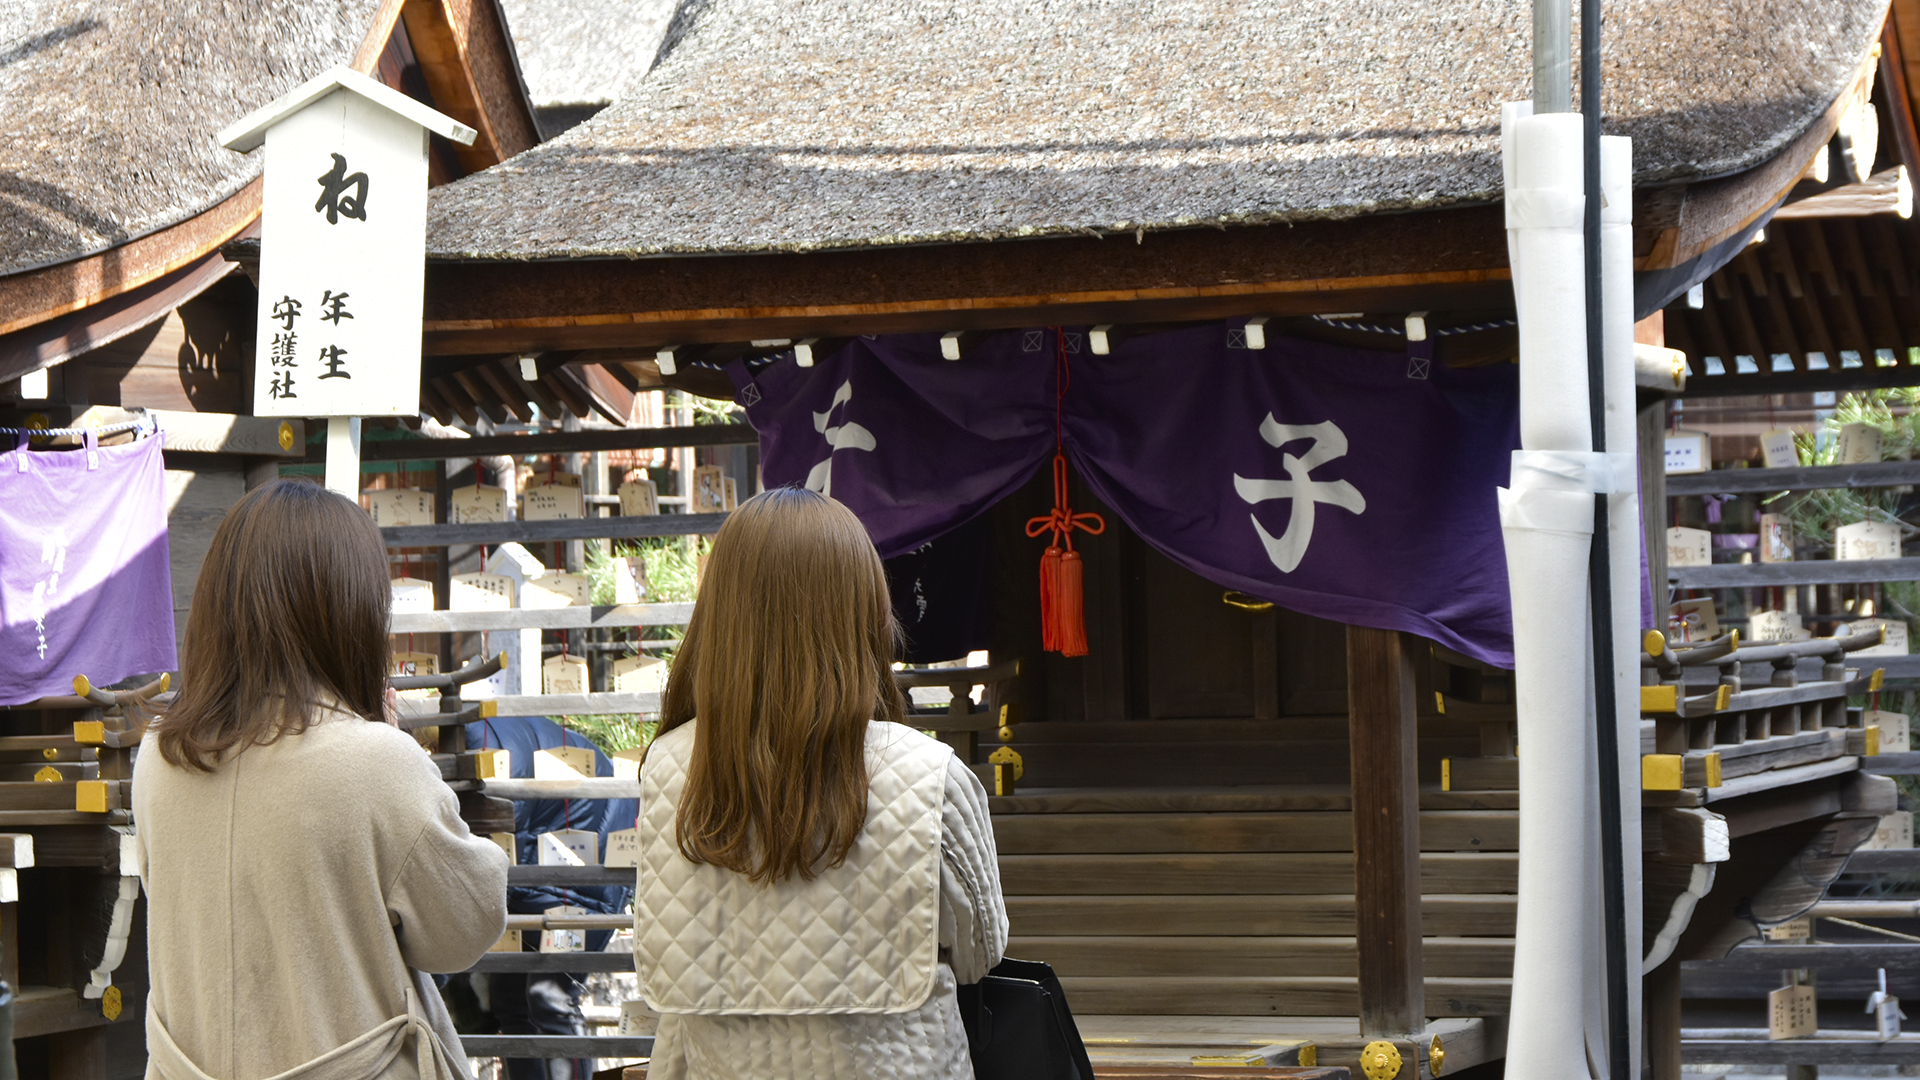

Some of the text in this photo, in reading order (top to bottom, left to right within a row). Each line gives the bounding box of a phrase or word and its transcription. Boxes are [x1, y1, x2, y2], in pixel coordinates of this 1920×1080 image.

[268, 295, 303, 400] 守護社
[315, 152, 369, 380] ね 年生
[1233, 411, 1367, 574] 子
